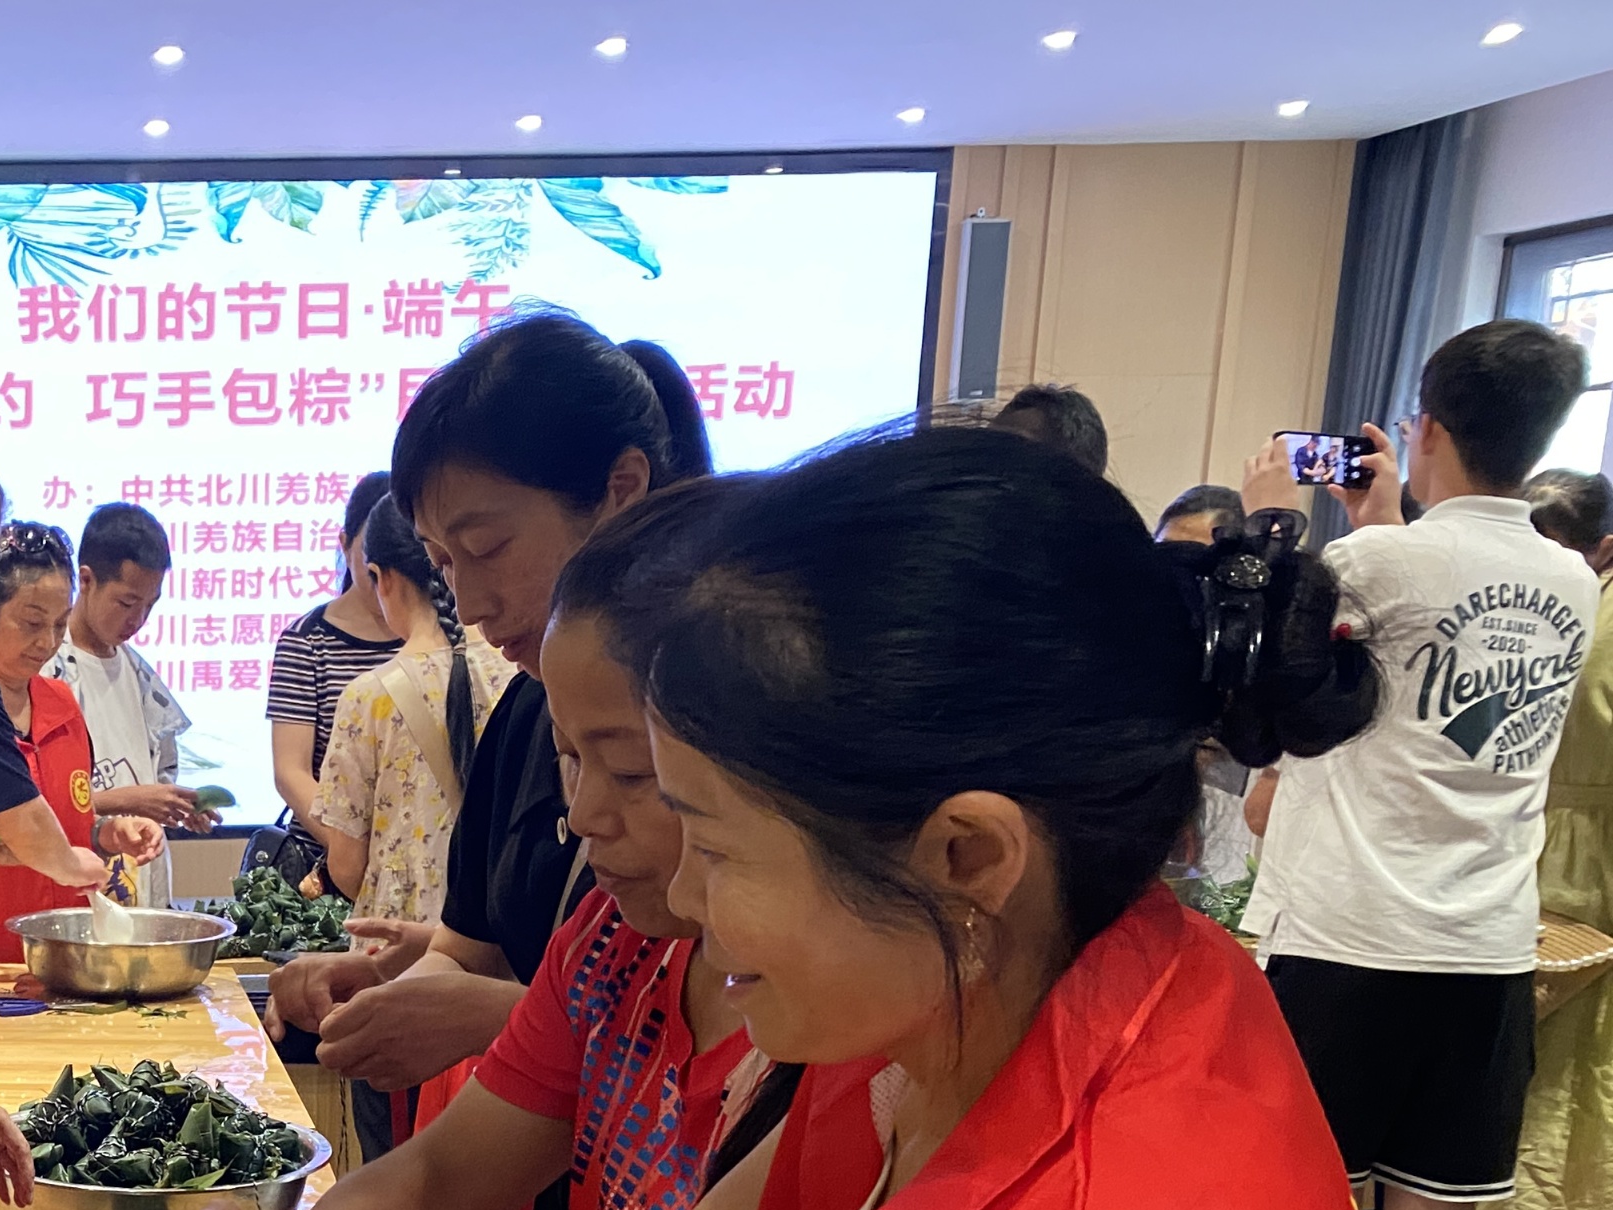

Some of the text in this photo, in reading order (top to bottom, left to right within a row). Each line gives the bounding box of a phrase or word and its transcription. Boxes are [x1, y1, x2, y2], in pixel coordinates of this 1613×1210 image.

[17, 277, 514, 343] 我们的节日·端午
